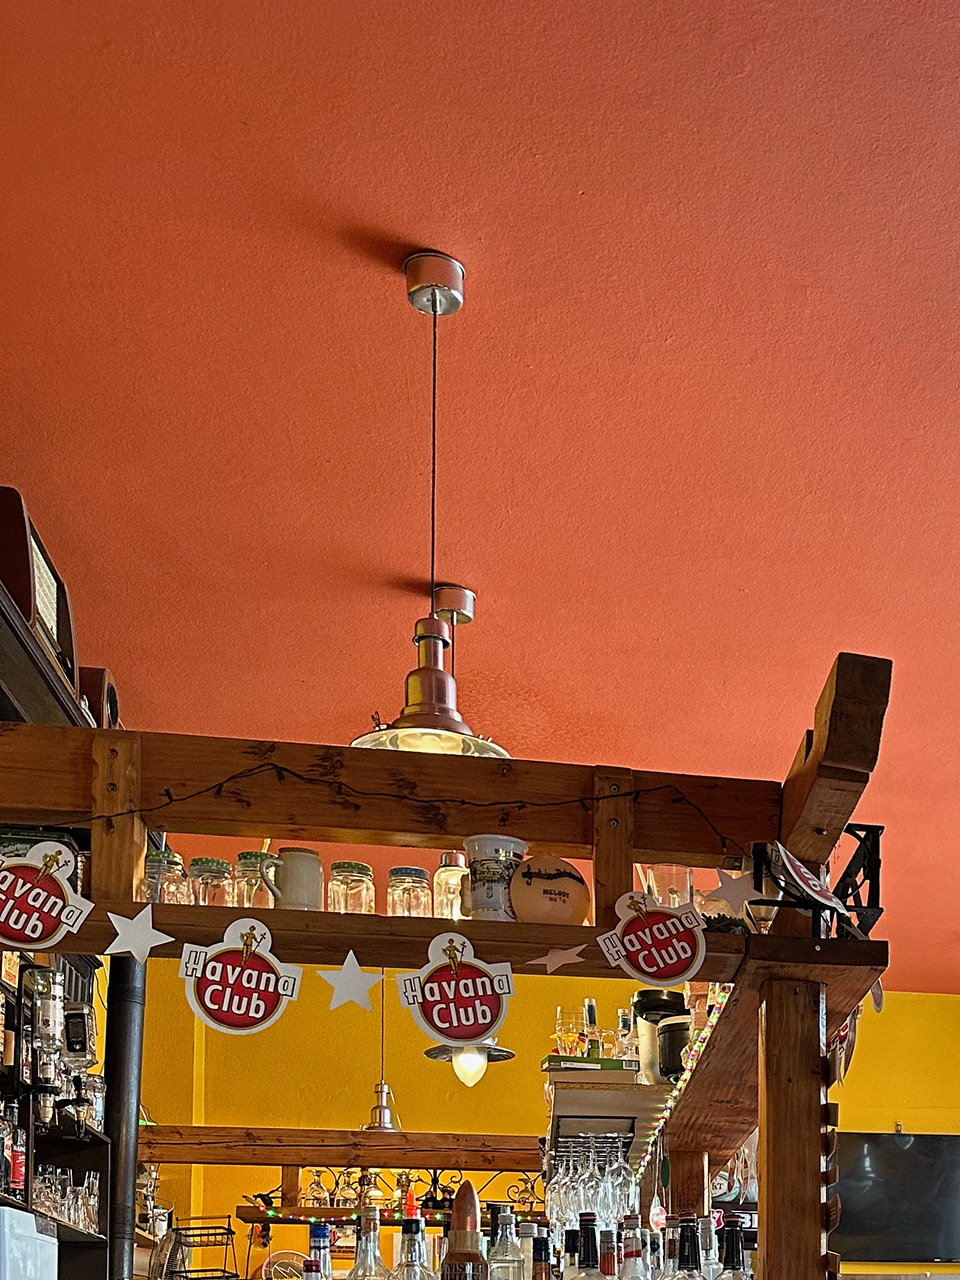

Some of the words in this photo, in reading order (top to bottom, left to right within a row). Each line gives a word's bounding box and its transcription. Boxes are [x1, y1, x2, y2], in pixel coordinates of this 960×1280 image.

[0, 858, 83, 928] avana
[602, 909, 701, 961] Havana
[638, 937, 692, 973] Club
[185, 950, 297, 997] Havana
[403, 974, 512, 1005] Havana
[204, 984, 266, 1019] Club
[432, 999, 492, 1029] Club
